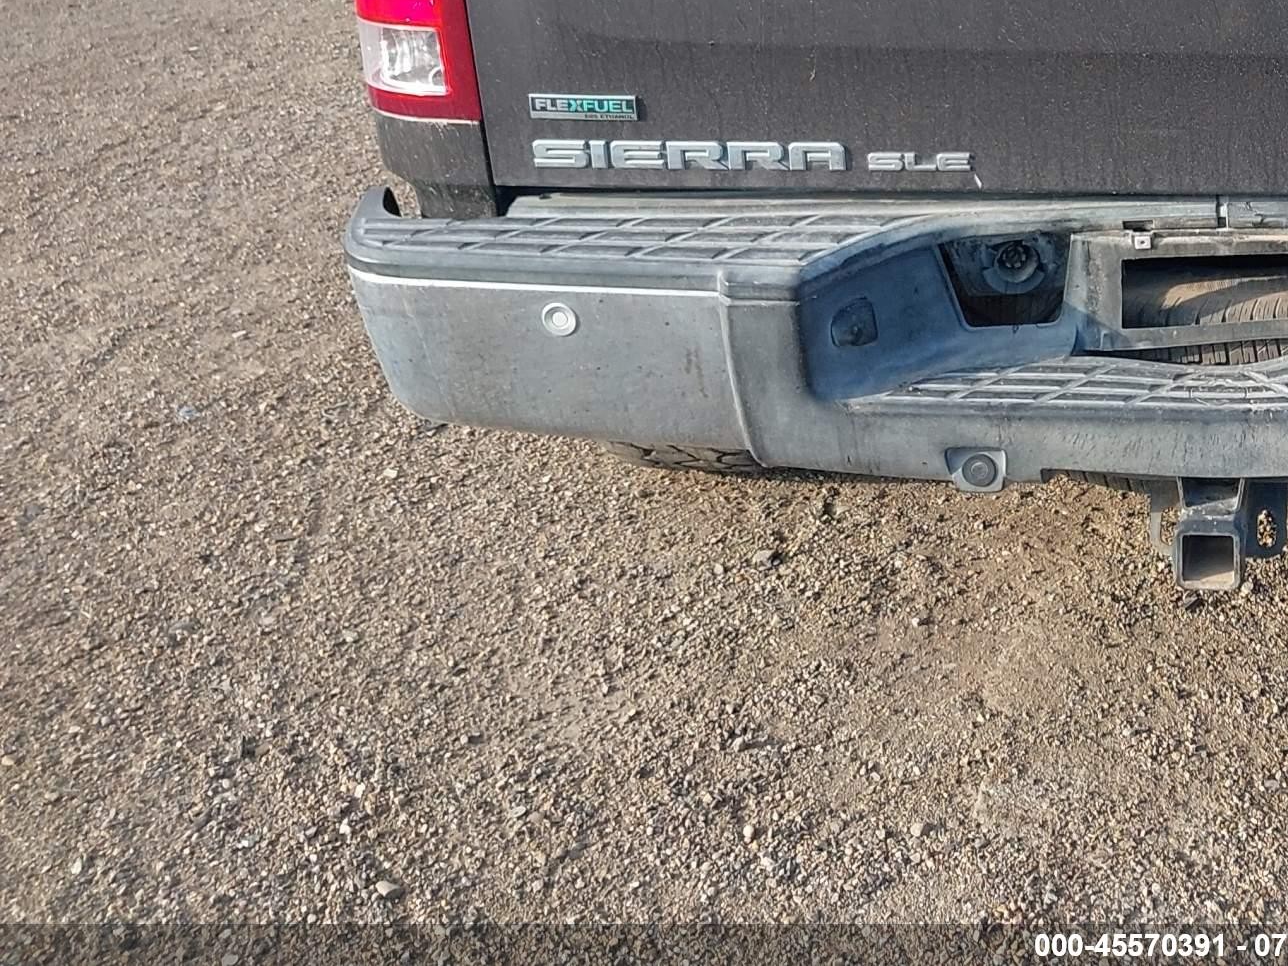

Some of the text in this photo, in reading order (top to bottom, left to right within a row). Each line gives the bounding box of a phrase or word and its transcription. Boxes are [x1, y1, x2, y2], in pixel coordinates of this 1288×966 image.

[534, 98, 633, 113] FLEXFUEL
[532, 138, 848, 172] SIERRA
[866, 151, 976, 172] SLE
